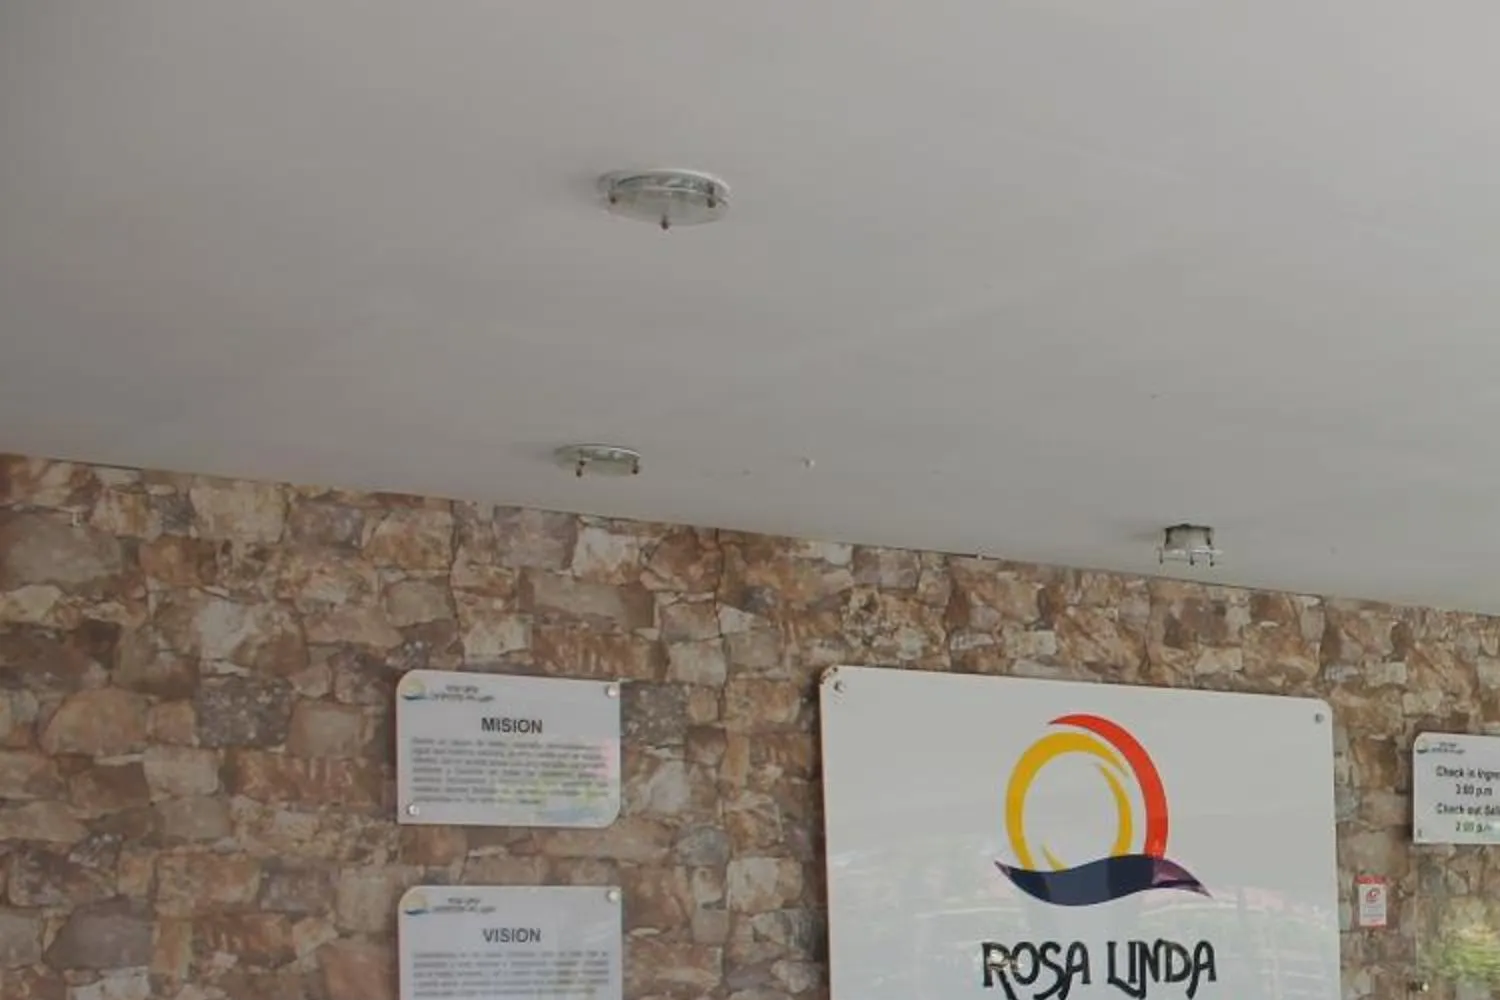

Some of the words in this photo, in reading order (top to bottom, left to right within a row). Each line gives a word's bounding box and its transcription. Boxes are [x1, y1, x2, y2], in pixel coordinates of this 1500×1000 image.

[481, 717, 543, 734] MISION
[1436, 765, 1465, 778] Check
[482, 928, 542, 943] VISION
